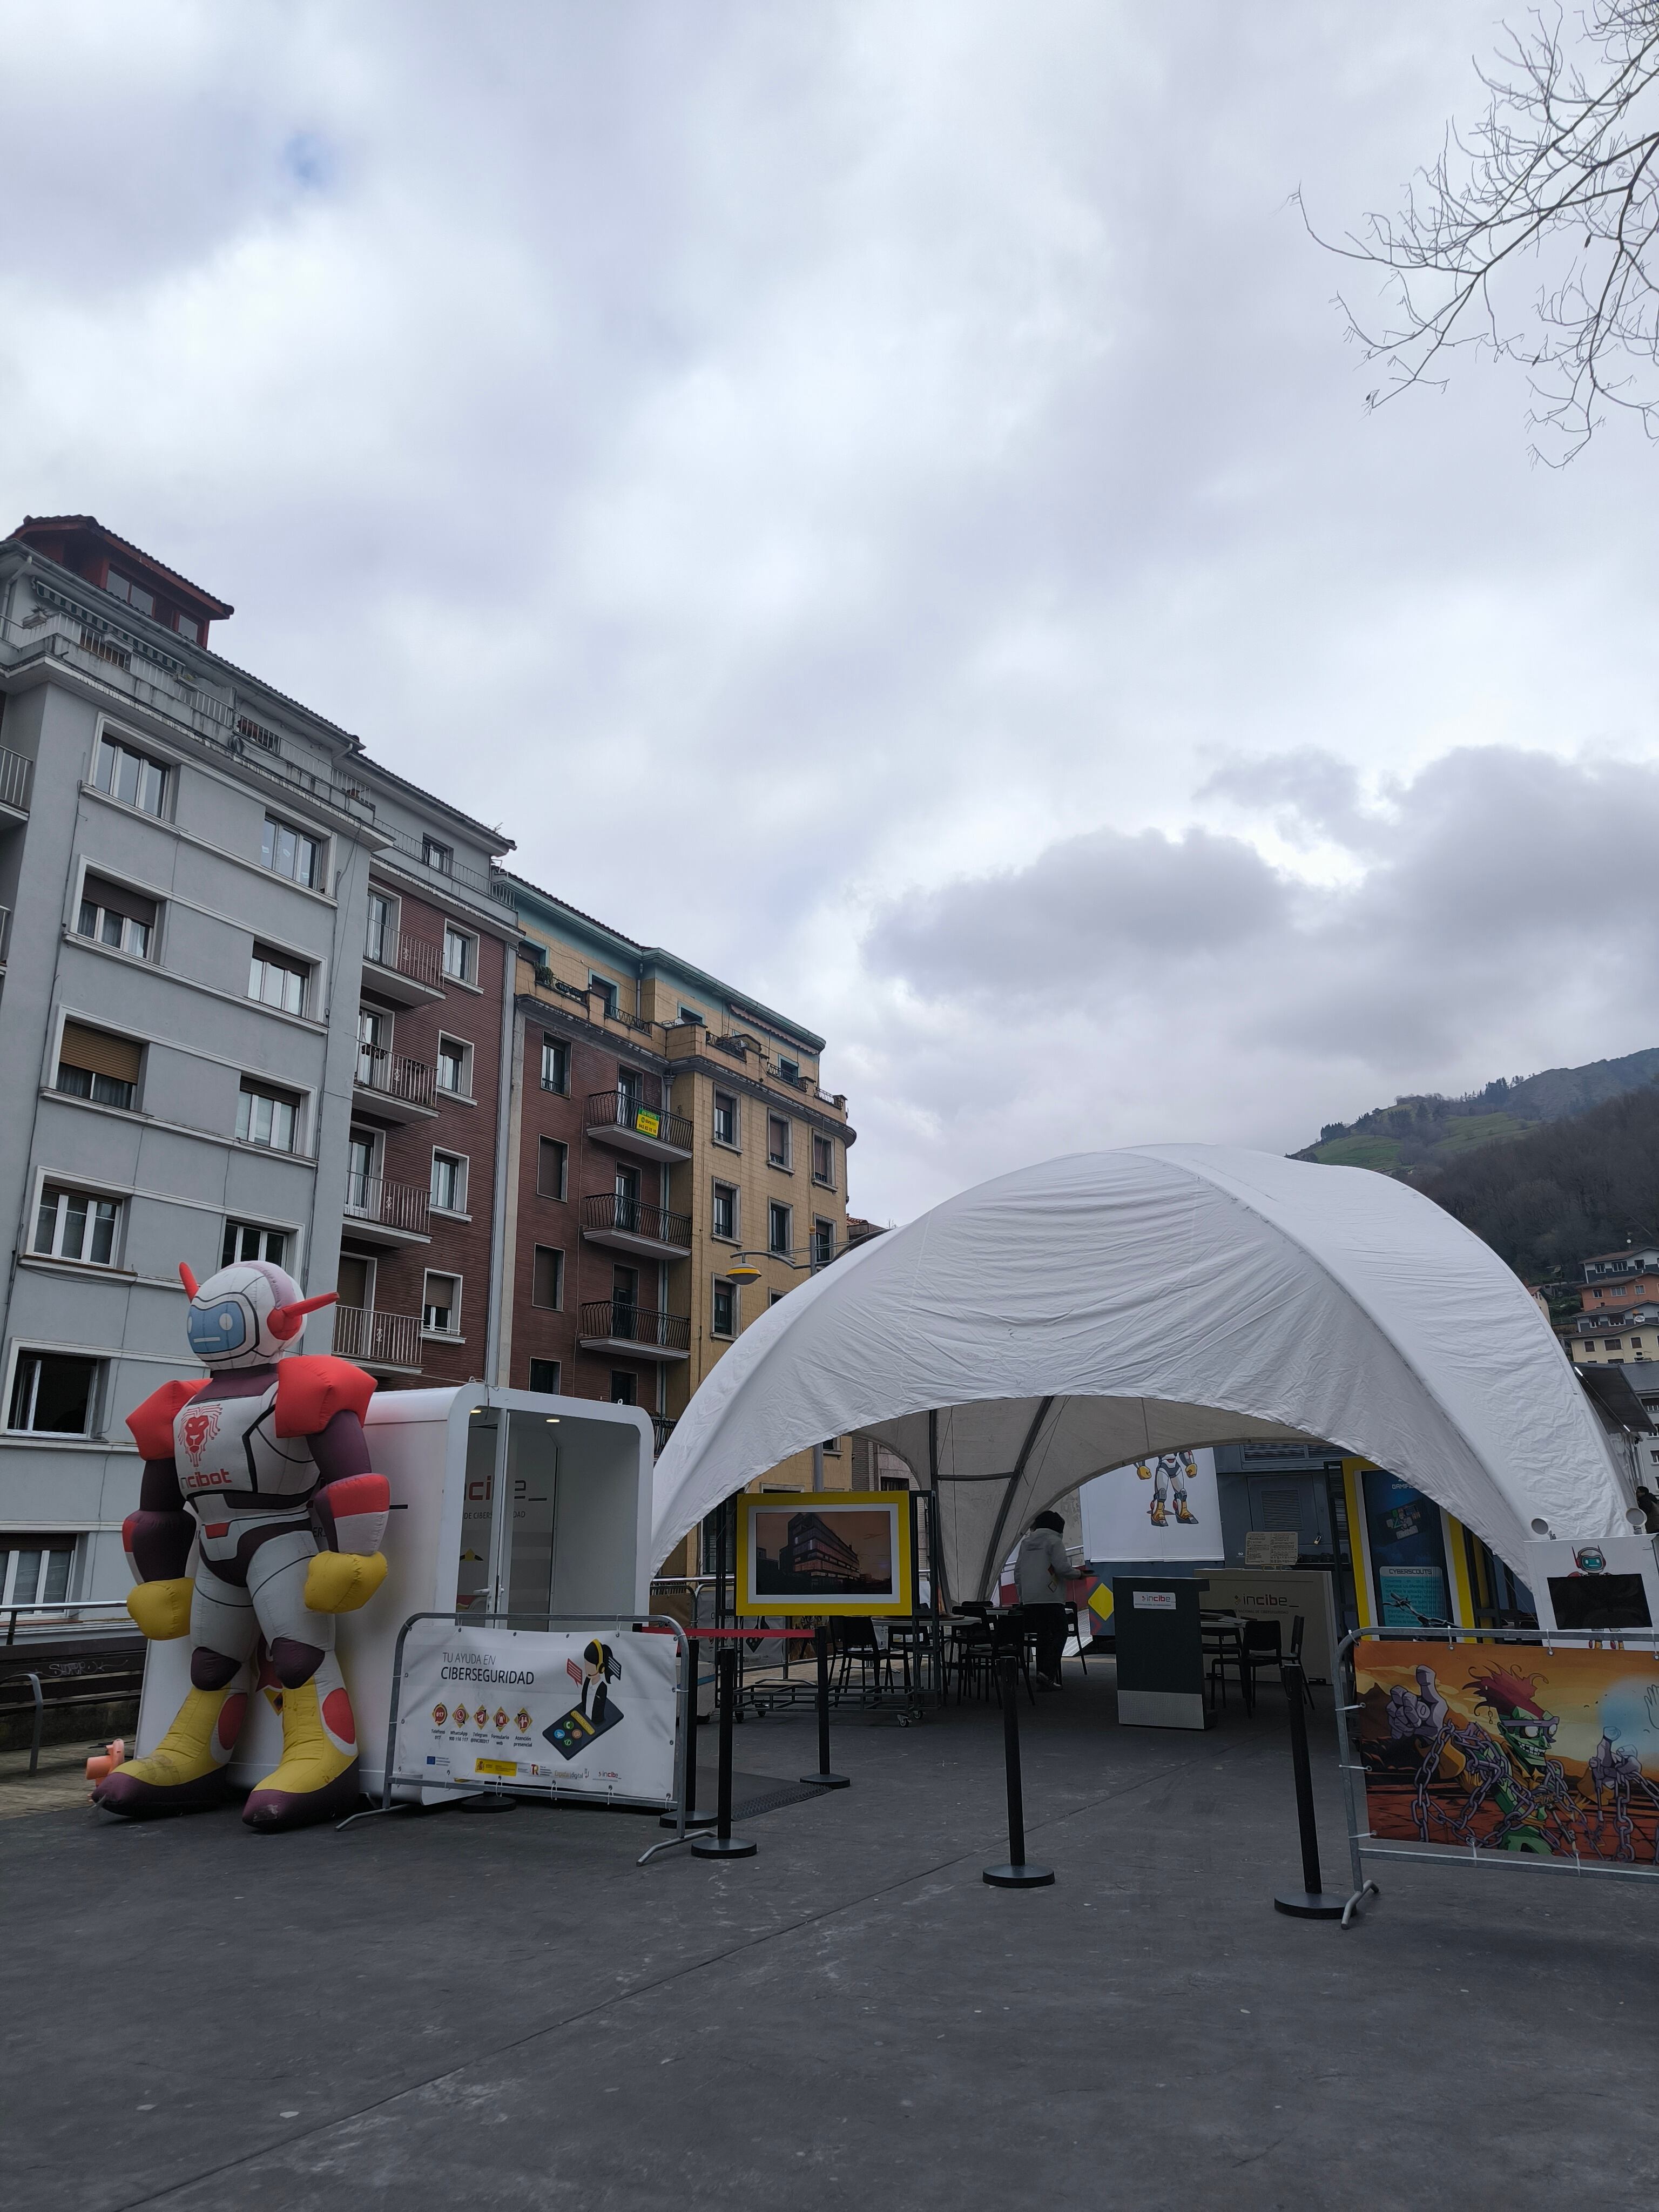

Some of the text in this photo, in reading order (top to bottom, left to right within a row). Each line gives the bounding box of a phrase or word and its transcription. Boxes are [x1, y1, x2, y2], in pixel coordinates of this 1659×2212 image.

[179, 1468, 233, 1489] ncibot
[442, 1652, 496, 1665] TU AYUDA EN
[441, 1667, 534, 1684] CIBERSEGURIDAD
